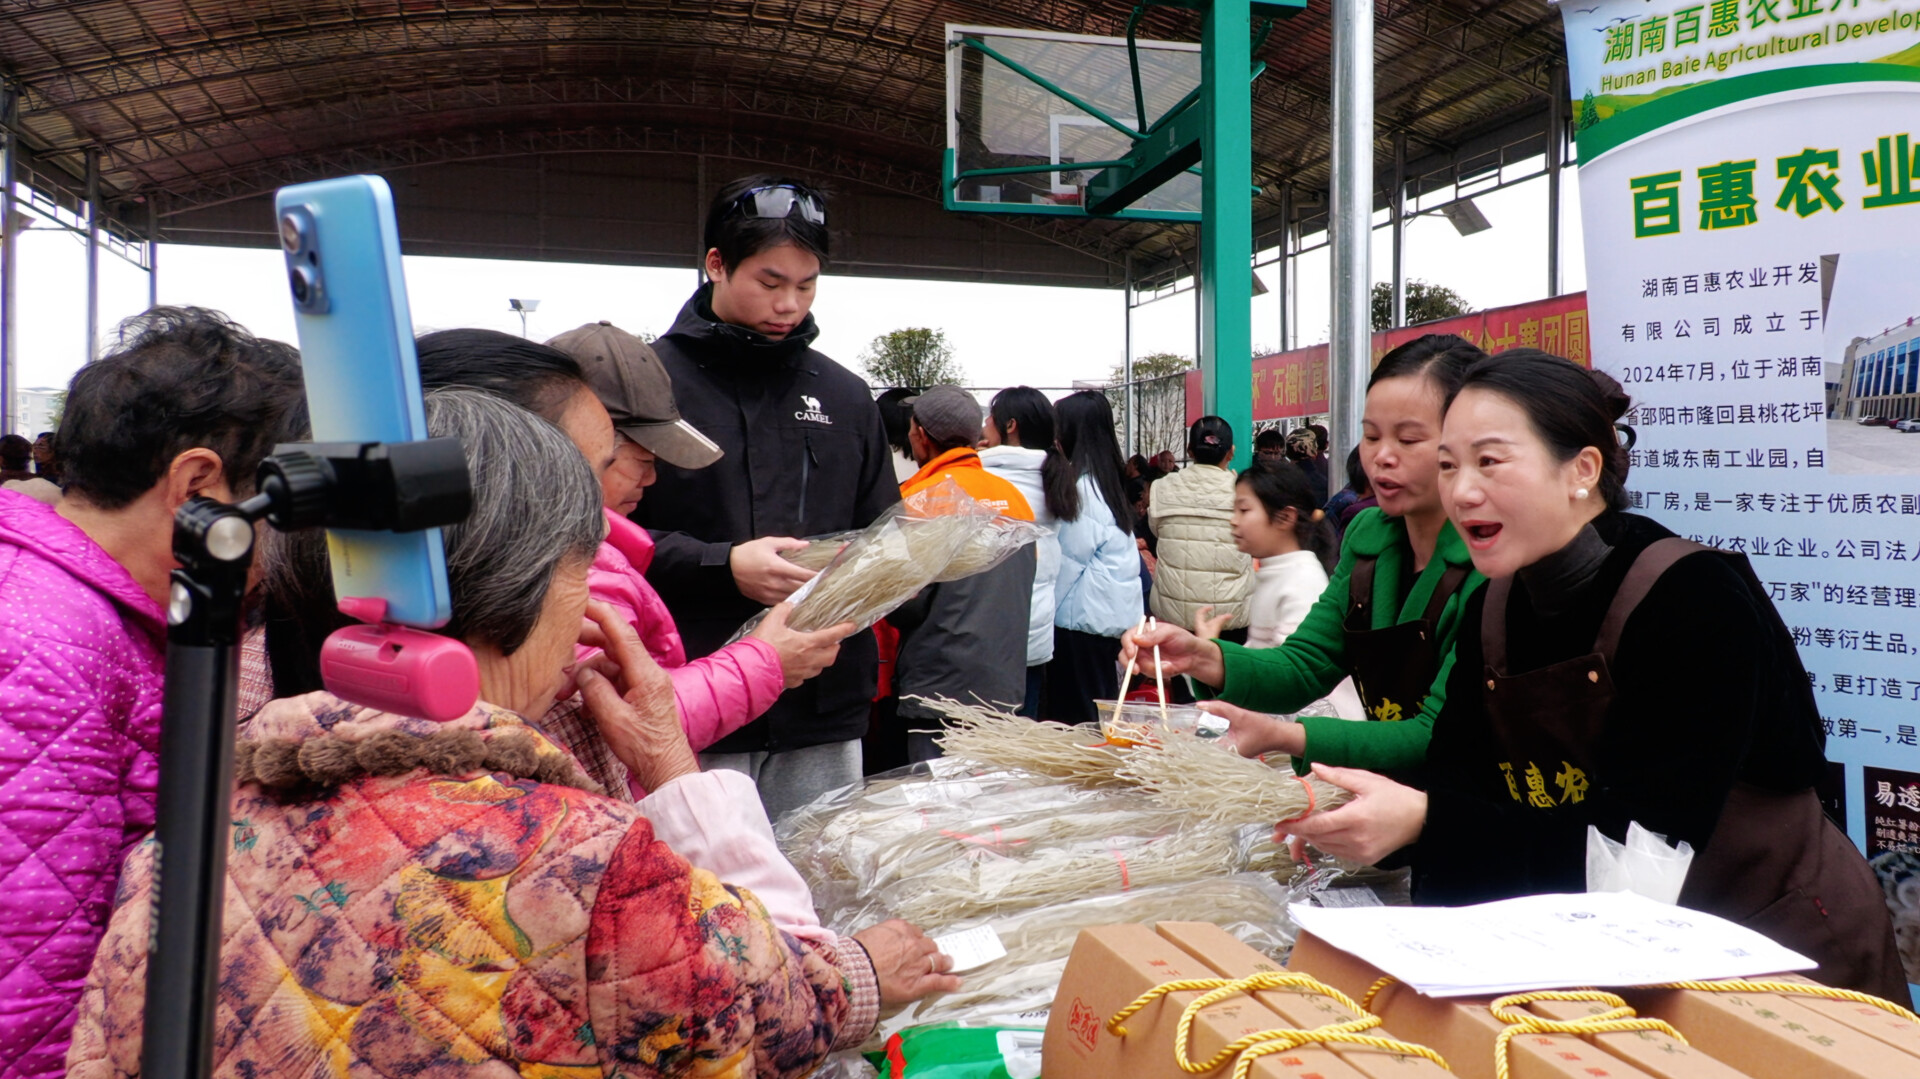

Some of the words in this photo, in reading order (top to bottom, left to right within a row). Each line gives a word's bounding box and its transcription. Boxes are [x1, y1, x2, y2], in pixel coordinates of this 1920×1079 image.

[1601, 69, 1656, 92] Hunan
[1662, 57, 1700, 77] Baie
[1705, 25, 1829, 71] Agricultural
[1630, 133, 1920, 239] 百惠农业
[1642, 262, 1819, 298] 湖南百惠农业开发
[1621, 309, 1820, 342] 有限公司成立于
[794, 411, 833, 424] CAMEL
[1626, 402, 1824, 426] 省邵阳市隆回县桃花坪
